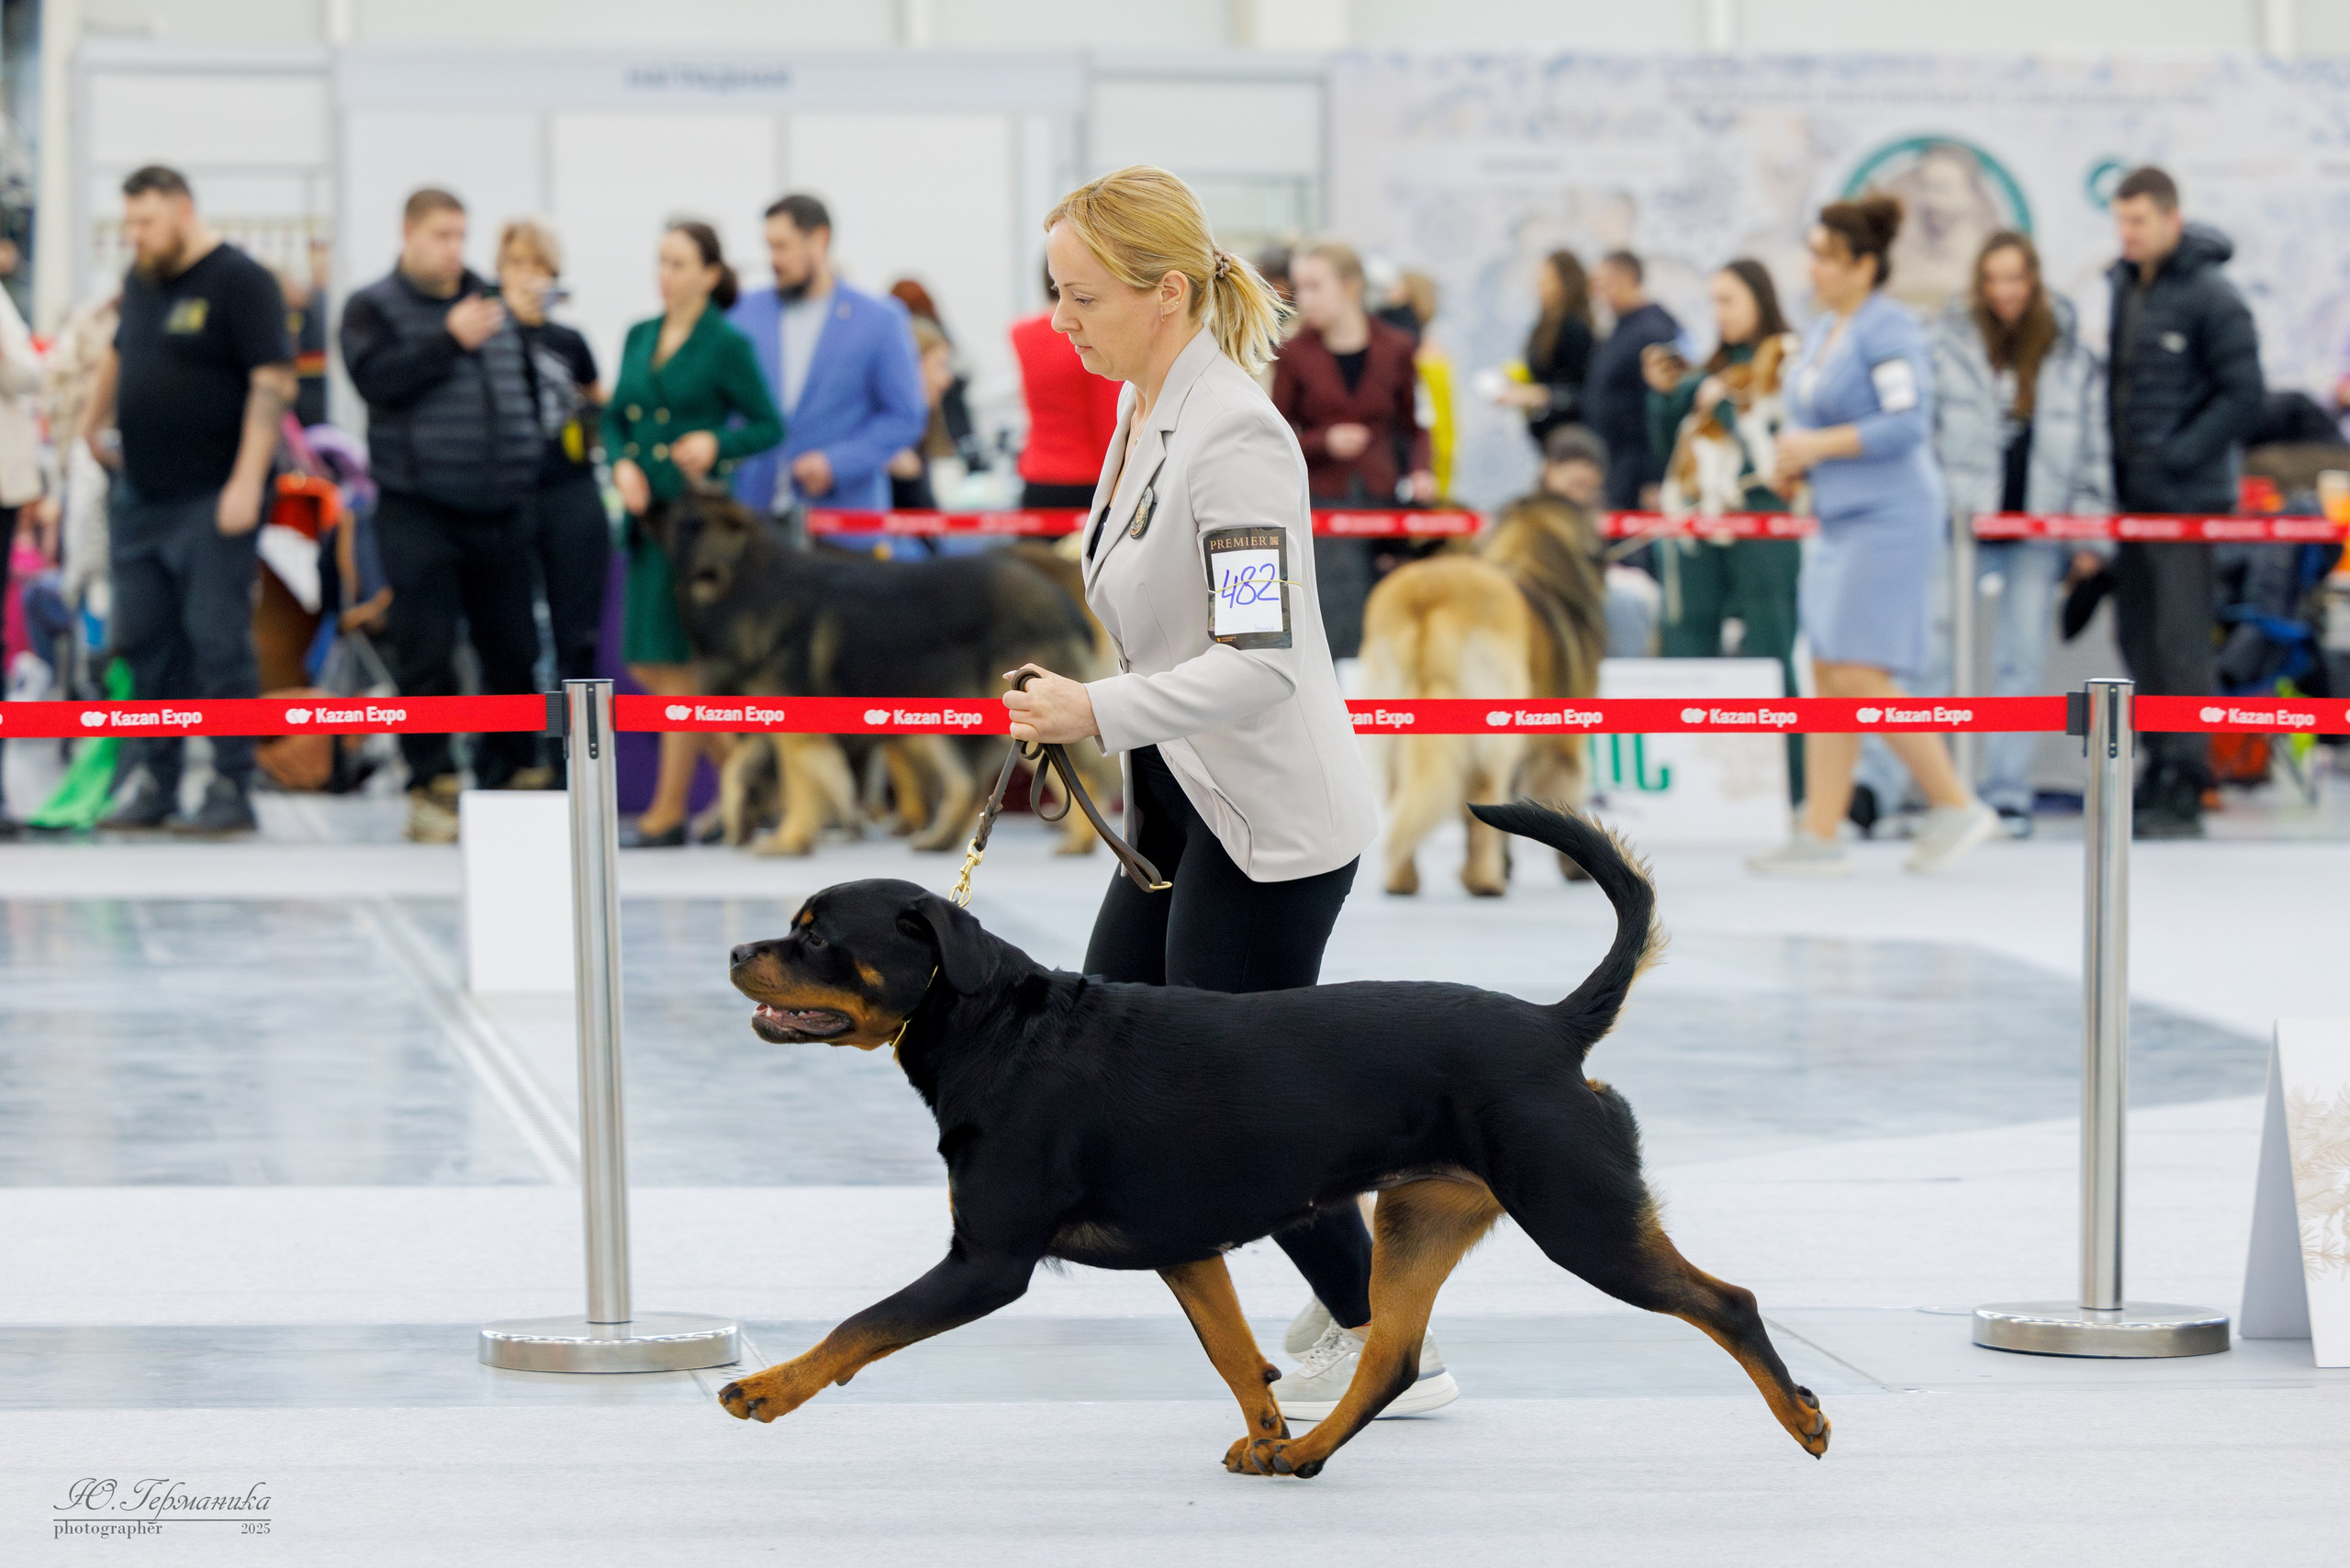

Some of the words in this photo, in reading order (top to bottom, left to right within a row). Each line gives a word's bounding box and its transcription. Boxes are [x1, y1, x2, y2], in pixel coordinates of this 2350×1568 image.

[1210, 536, 1267, 550] PREMIER
[1221, 563, 1280, 609] 482
[111, 711, 160, 726] Kazan
[162, 710, 203, 729] Expo
[316, 708, 364, 723] Kazan
[366, 706, 407, 726] Expo
[695, 706, 743, 722] Kazan
[745, 706, 785, 725] Expo
[893, 710, 941, 724] Kazan
[944, 710, 983, 728] Expo
[1375, 709, 1415, 728] Expo
[1516, 711, 1561, 725] Kazan
[1564, 709, 1603, 728] Expo
[1709, 709, 1756, 723] Kazan
[1758, 709, 1797, 728] Expo
[1885, 708, 1931, 722] Kazan
[1933, 707, 1973, 725] Expo
[2229, 709, 2275, 724] Kazan
[2277, 710, 2316, 728] Expo
